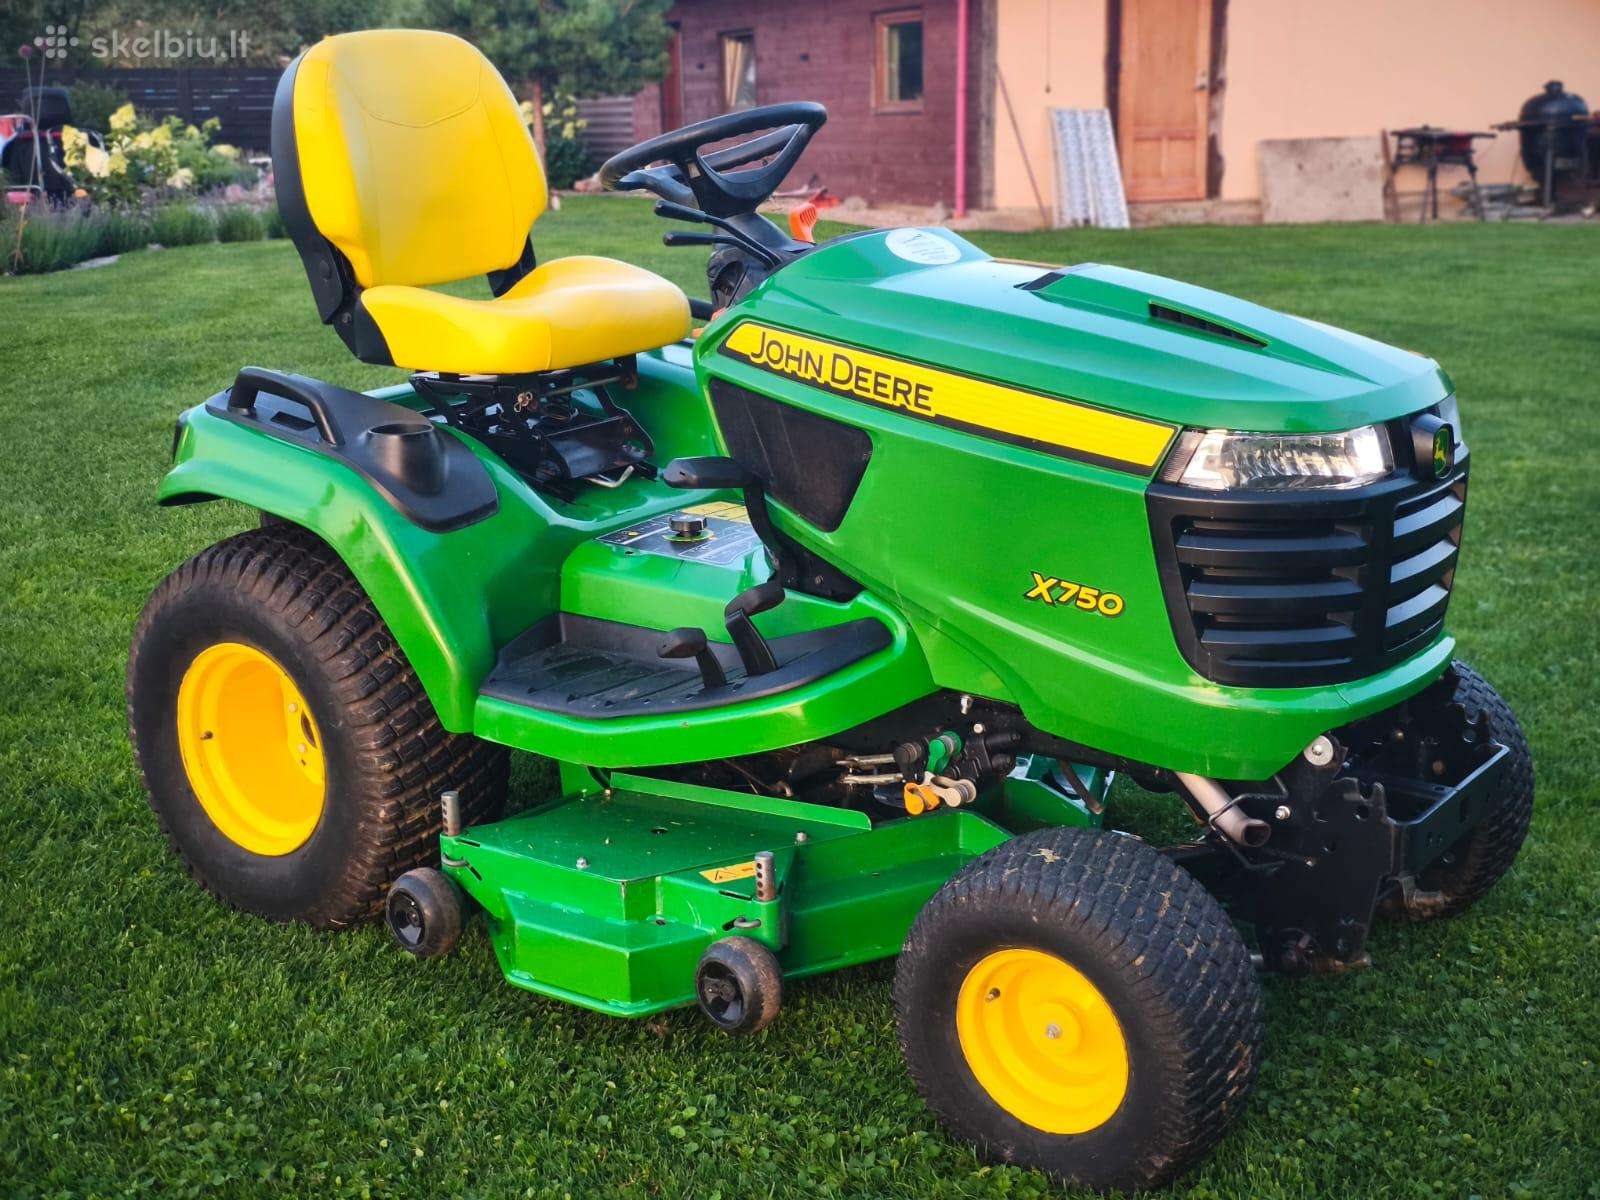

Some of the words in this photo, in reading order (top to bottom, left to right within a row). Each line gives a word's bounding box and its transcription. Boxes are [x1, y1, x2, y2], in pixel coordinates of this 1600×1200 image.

[750, 331, 824, 379] JOHN
[830, 352, 934, 412] DEERE
[1023, 571, 1125, 618] X750
